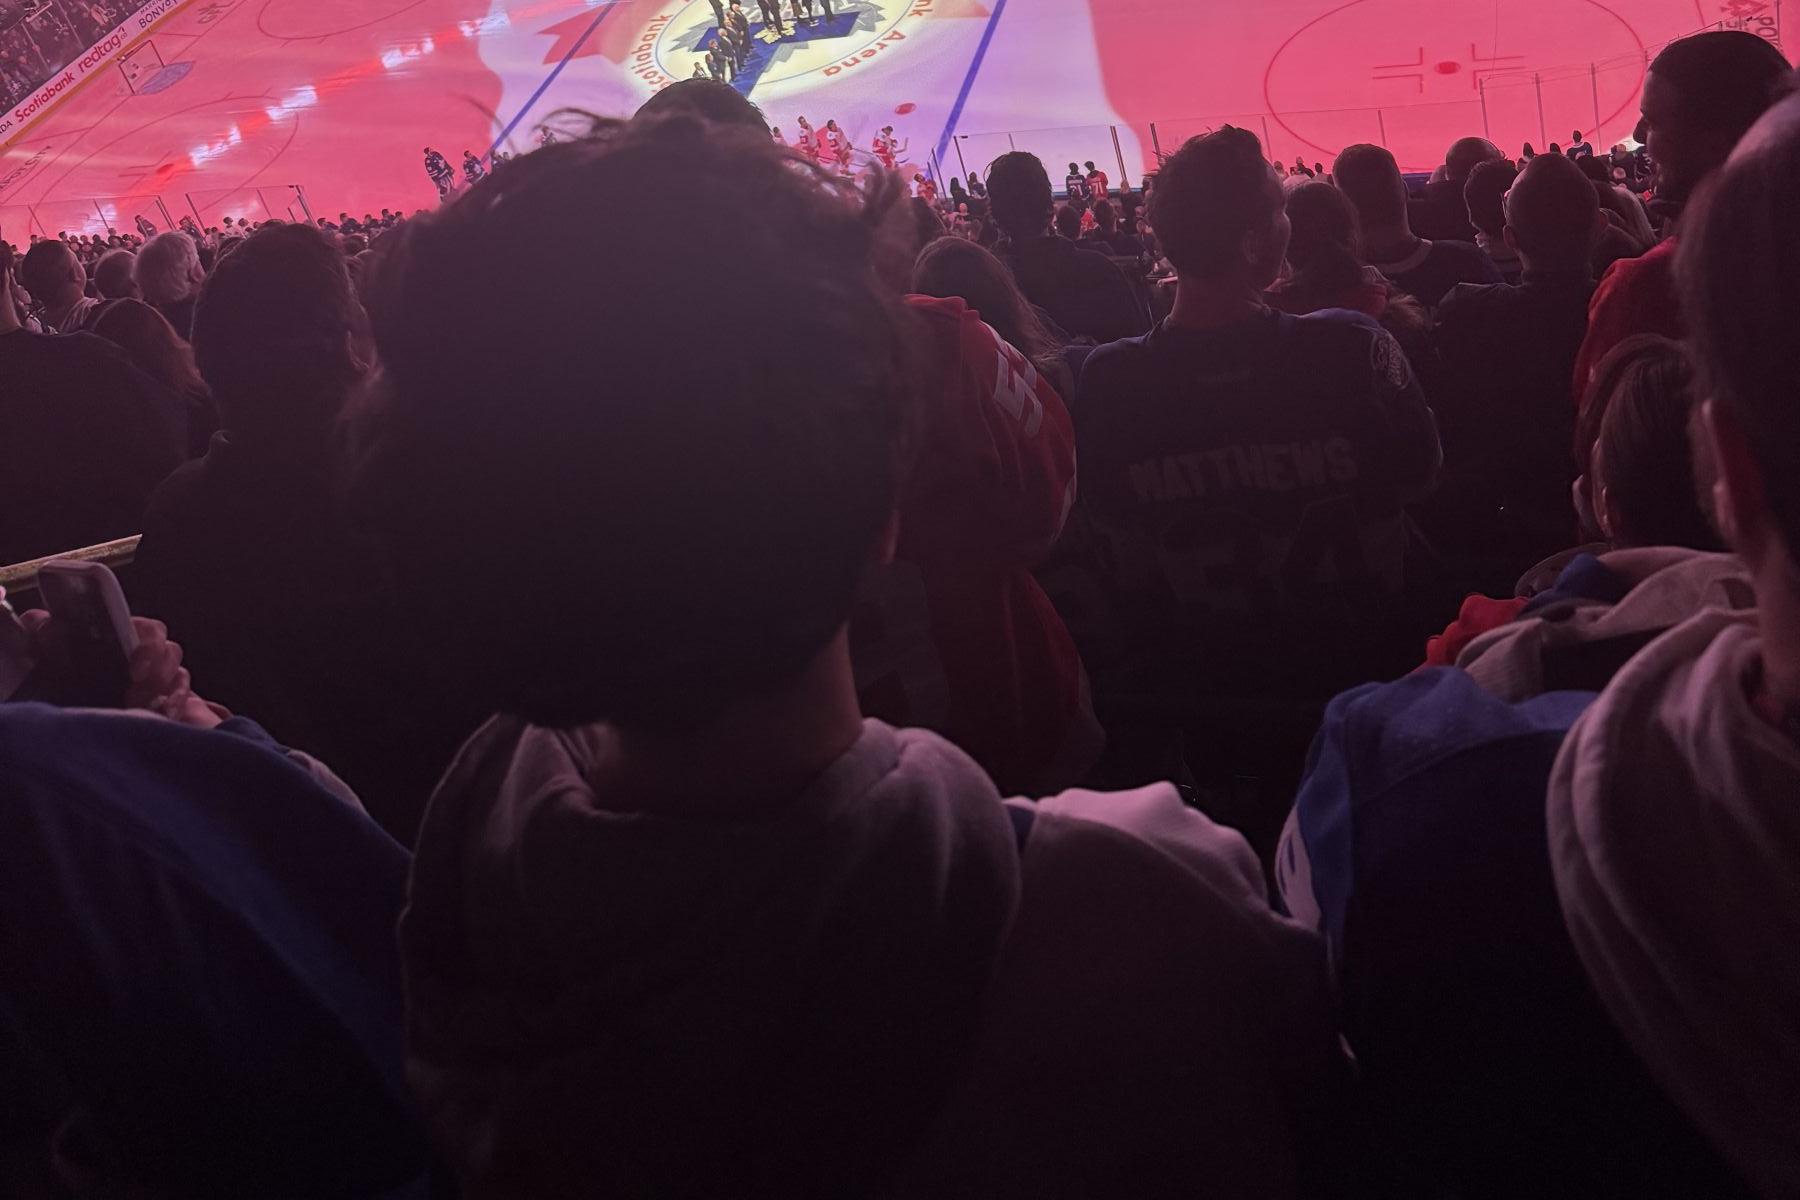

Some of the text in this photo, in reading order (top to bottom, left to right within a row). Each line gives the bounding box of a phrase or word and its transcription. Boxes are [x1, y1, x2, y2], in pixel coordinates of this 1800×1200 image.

[823, 29, 906, 78] Arena
[15, 71, 75, 123] Scotiabank
[1129, 436, 1359, 502] MATTHEWS
